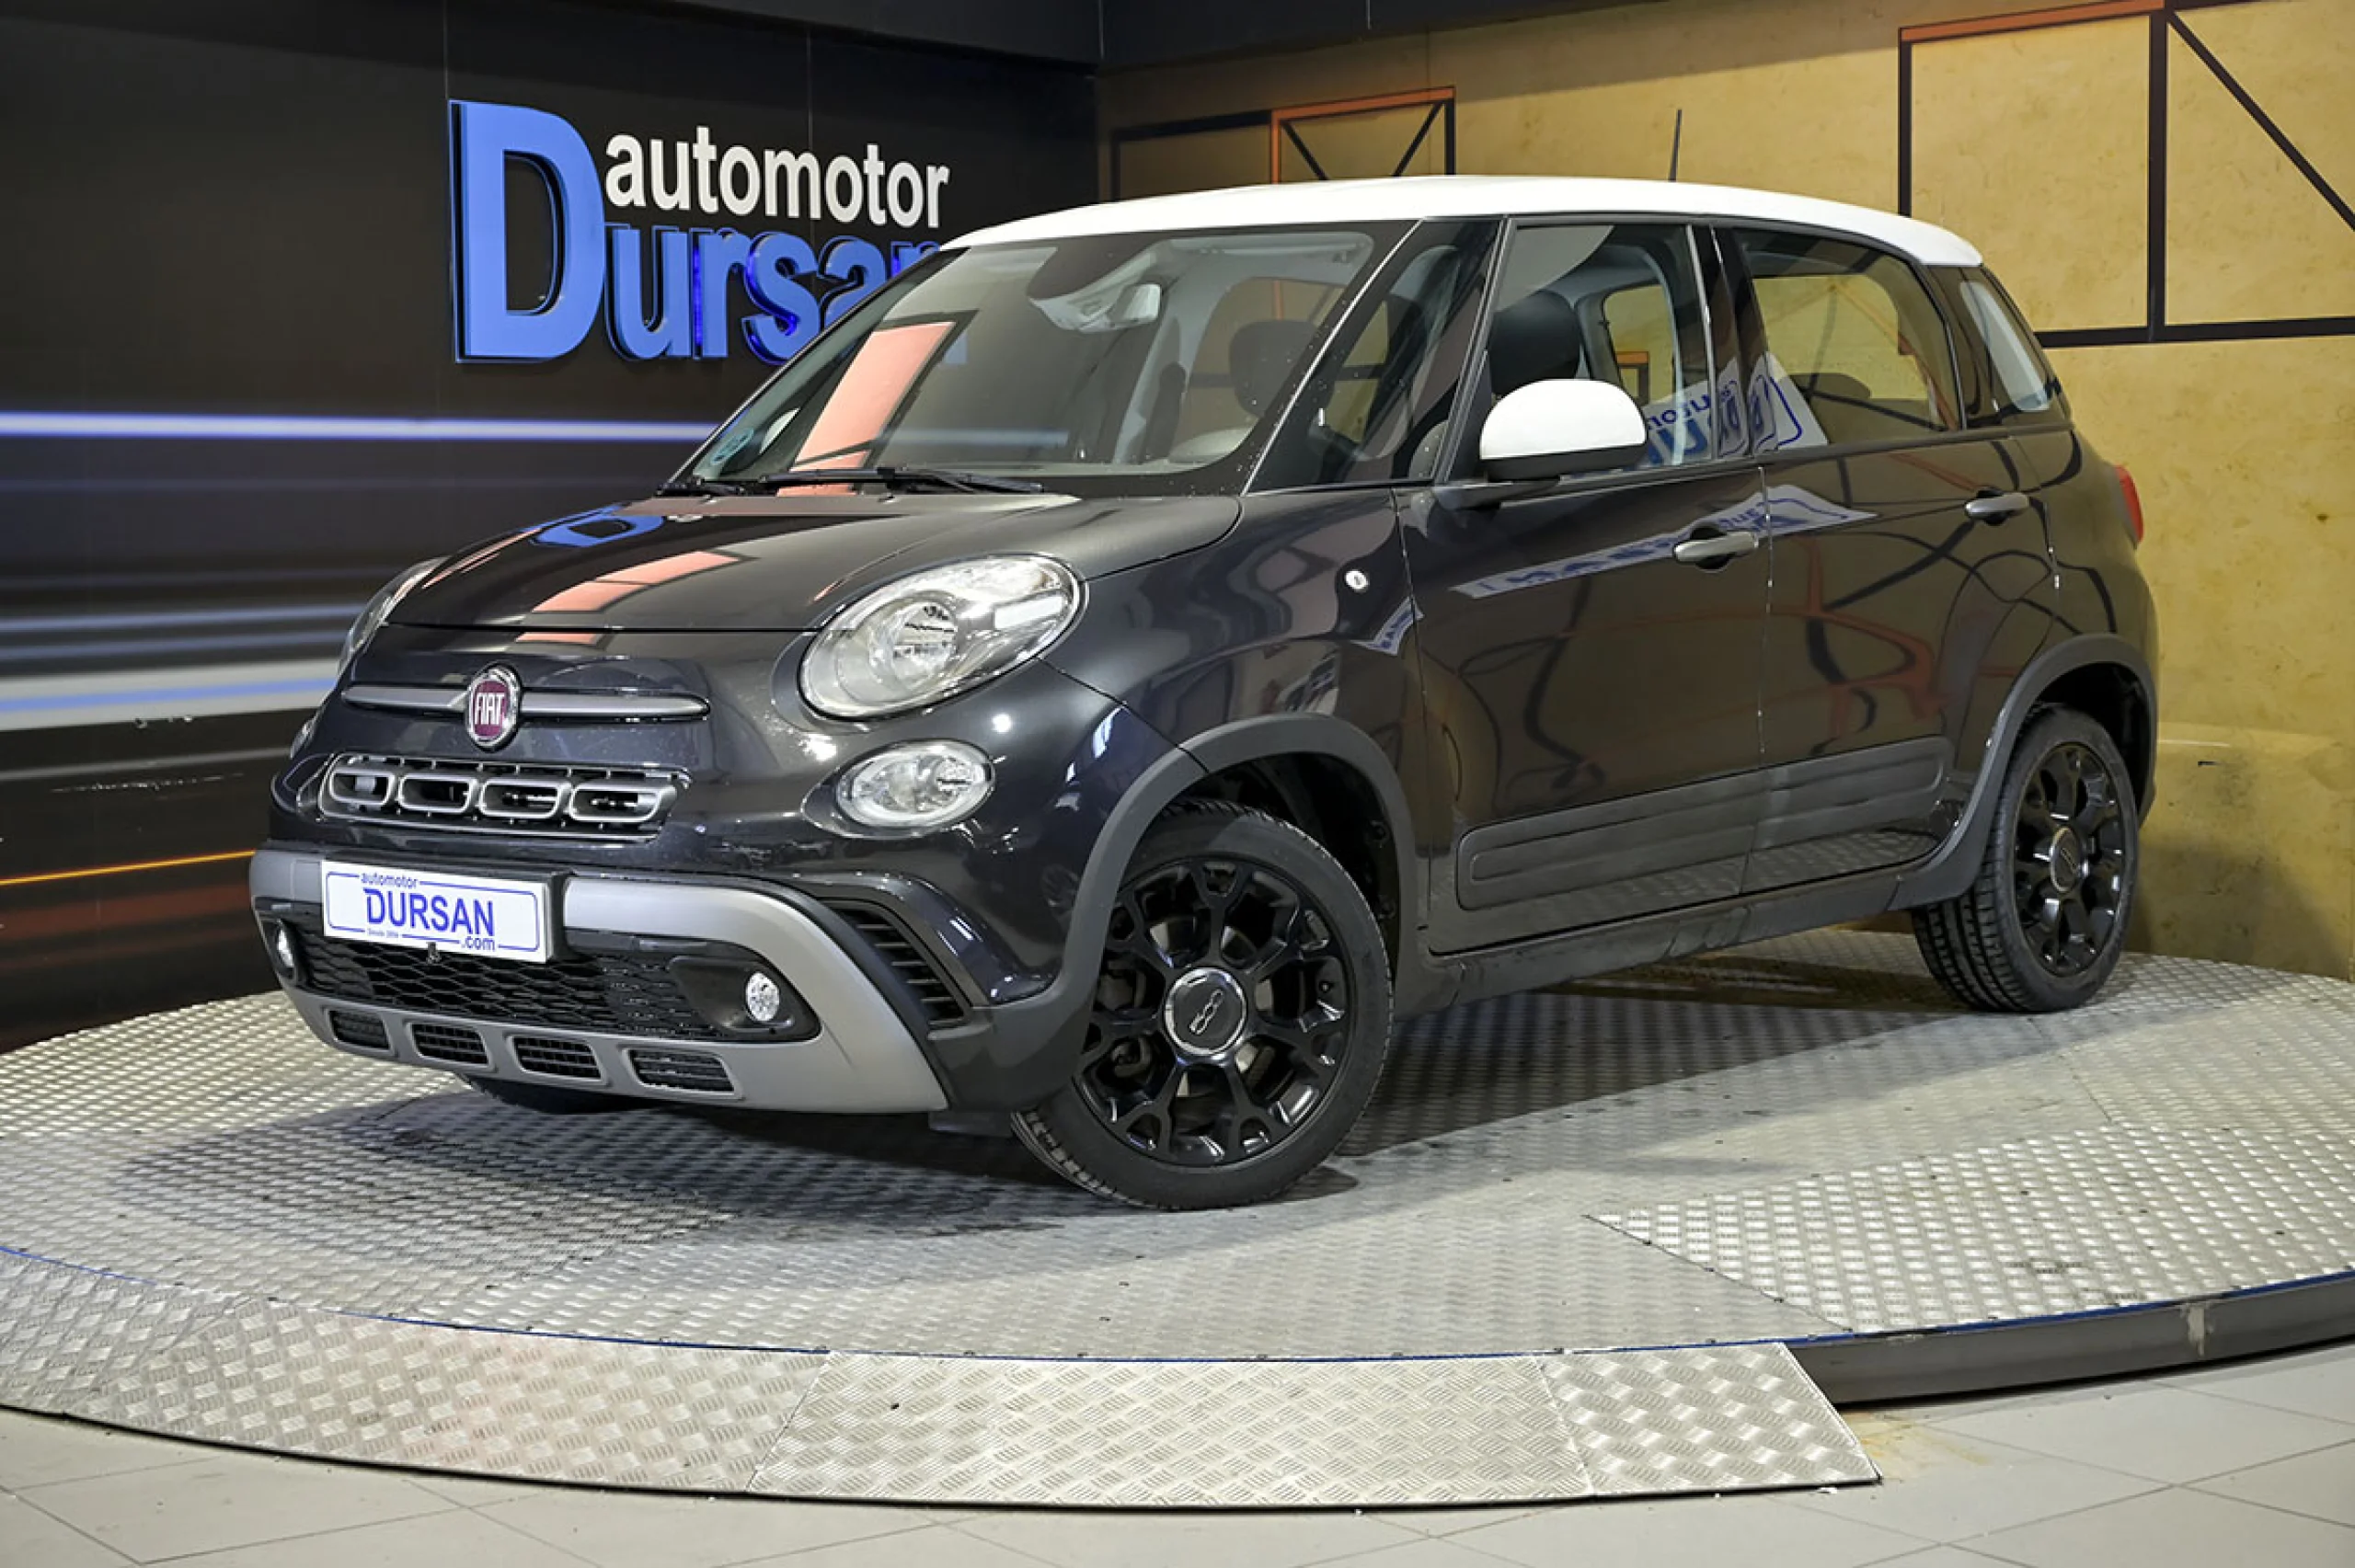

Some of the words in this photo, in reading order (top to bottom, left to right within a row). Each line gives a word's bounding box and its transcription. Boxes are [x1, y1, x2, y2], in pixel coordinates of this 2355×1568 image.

[604, 124, 950, 229] automotor
[474, 692, 505, 726] FIAT
[361, 872, 419, 889] automotor
[362, 887, 496, 937] DURSAN
[461, 936, 497, 952] .com
